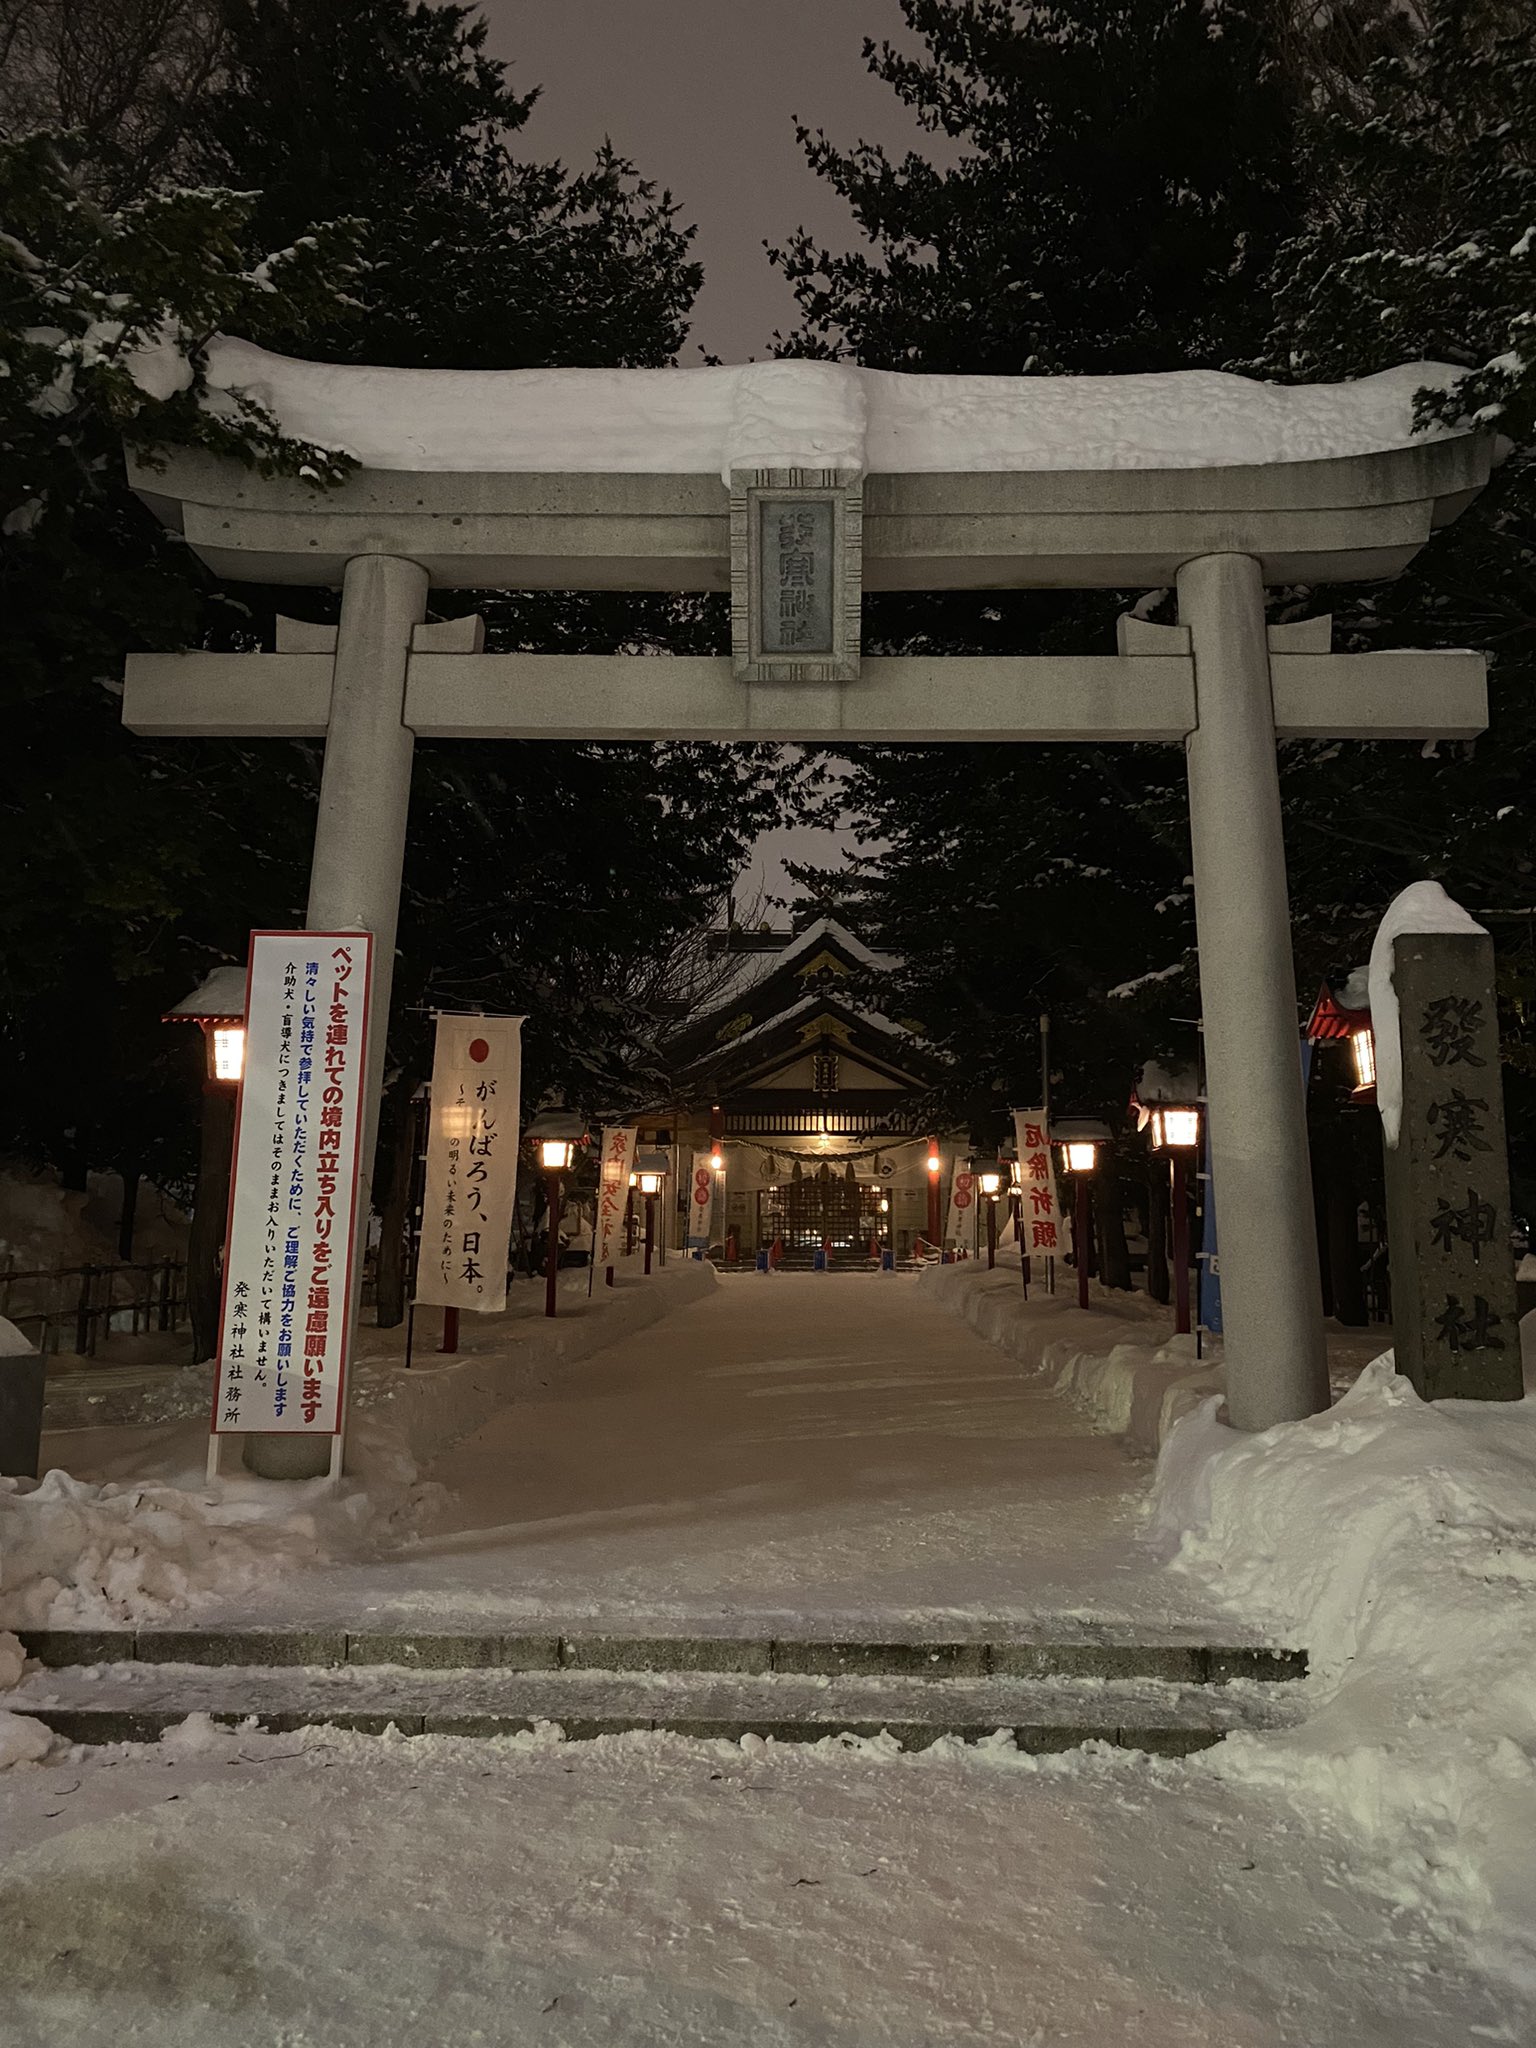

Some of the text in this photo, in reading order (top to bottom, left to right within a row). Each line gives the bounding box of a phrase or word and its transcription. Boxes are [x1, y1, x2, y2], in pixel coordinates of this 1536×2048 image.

[223, 1281, 251, 1424] 発寒神社社務所
[254, 962, 297, 1388] 介助犬・盲導犬につきましてはそのままお入りいただいて構いません。
[274, 962, 319, 1417] 清々しい気持で参拝していただくために、ご理解ご協力をお願いします
[300, 946, 353, 1424] ペットを連れての境内立ち入りをご遠慮願います
[458, 1079, 498, 1294] がんばろう、日本。
[1420, 995, 1506, 1354] 發寒神社
